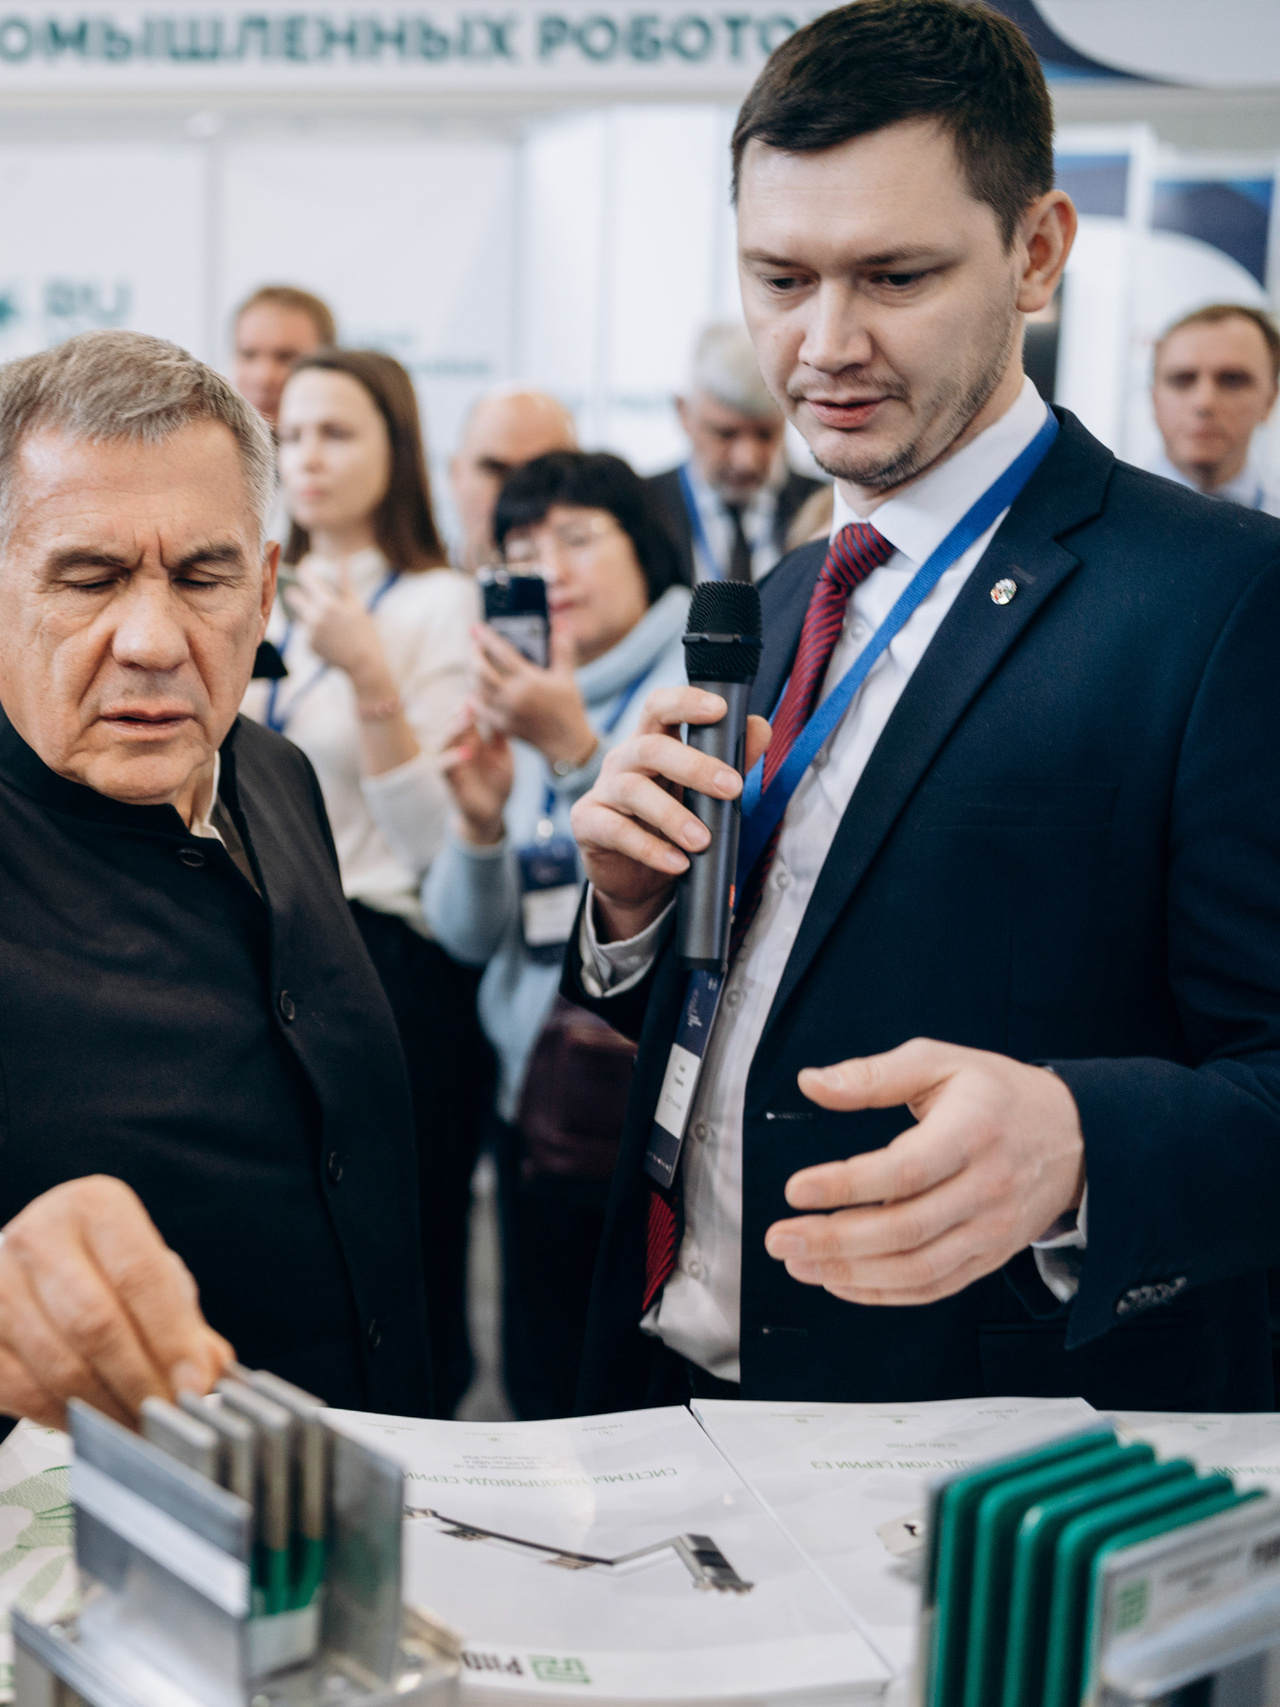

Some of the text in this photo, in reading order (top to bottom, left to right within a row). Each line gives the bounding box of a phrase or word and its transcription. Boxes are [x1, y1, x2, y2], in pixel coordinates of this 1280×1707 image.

[537, 14, 806, 63] РОБОТО
[464, 1475, 590, 1488] ТОКОПРОВОДА
[593, 1467, 677, 1485] СИСТЕМЫ
